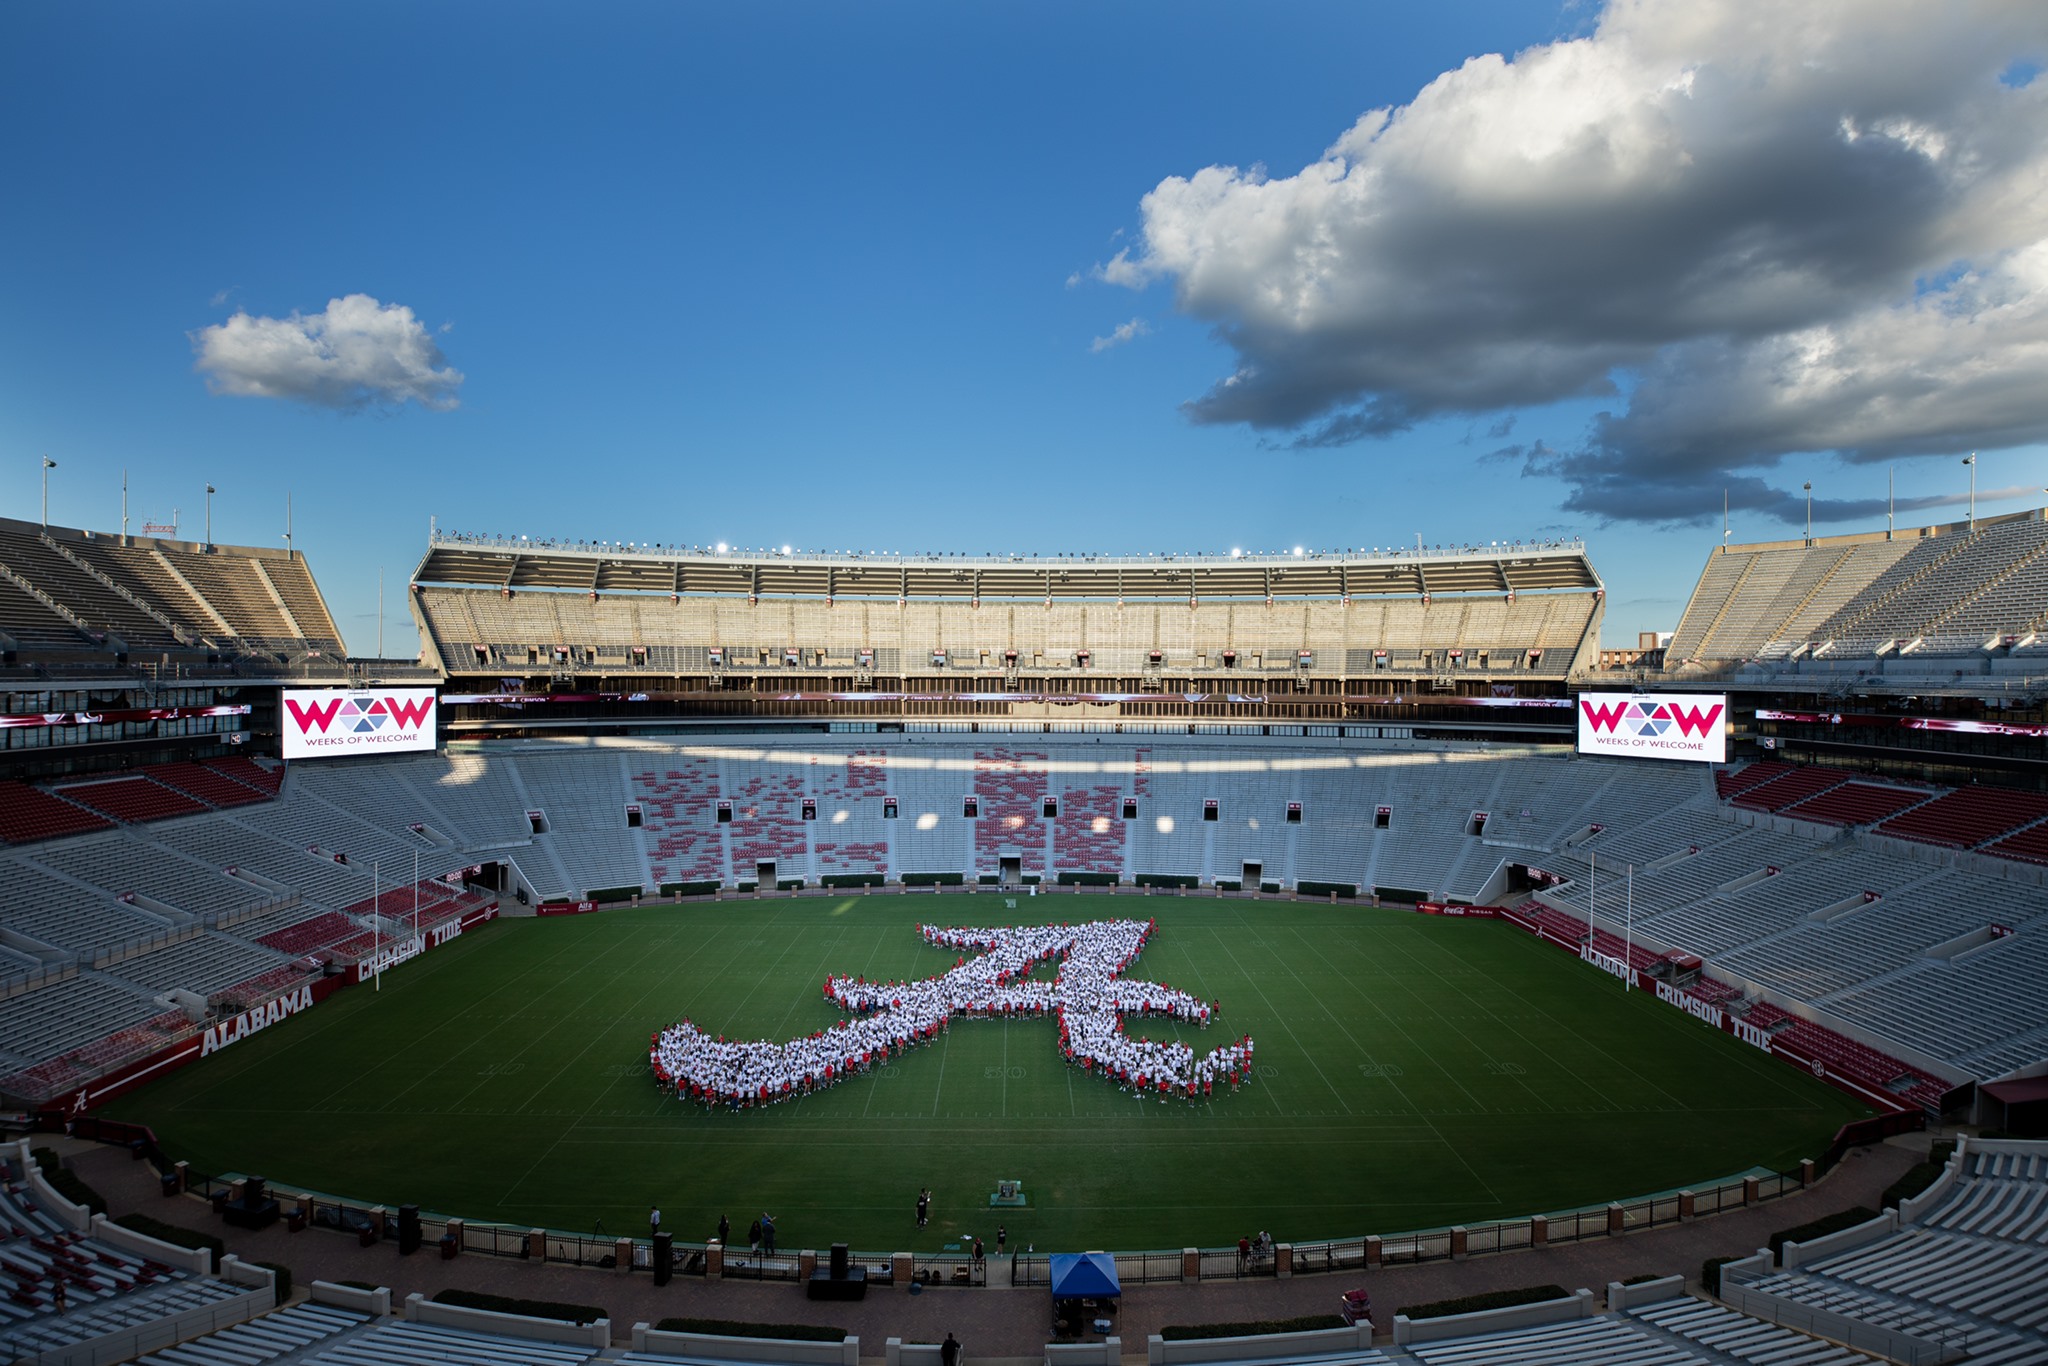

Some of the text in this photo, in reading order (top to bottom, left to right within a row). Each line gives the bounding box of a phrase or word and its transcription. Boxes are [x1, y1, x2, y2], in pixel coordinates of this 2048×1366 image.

[305, 733, 418, 746] WEEKS OF WELCOME
[1596, 737, 1704, 750] WEEKS OF WELCOME
[578, 901, 593, 910] Alfa
[358, 917, 463, 983] CRIMSON TIDE
[1579, 944, 1772, 1054] ALABAMA CRIMSON TIDE
[200, 985, 314, 1058] ALABAMA
